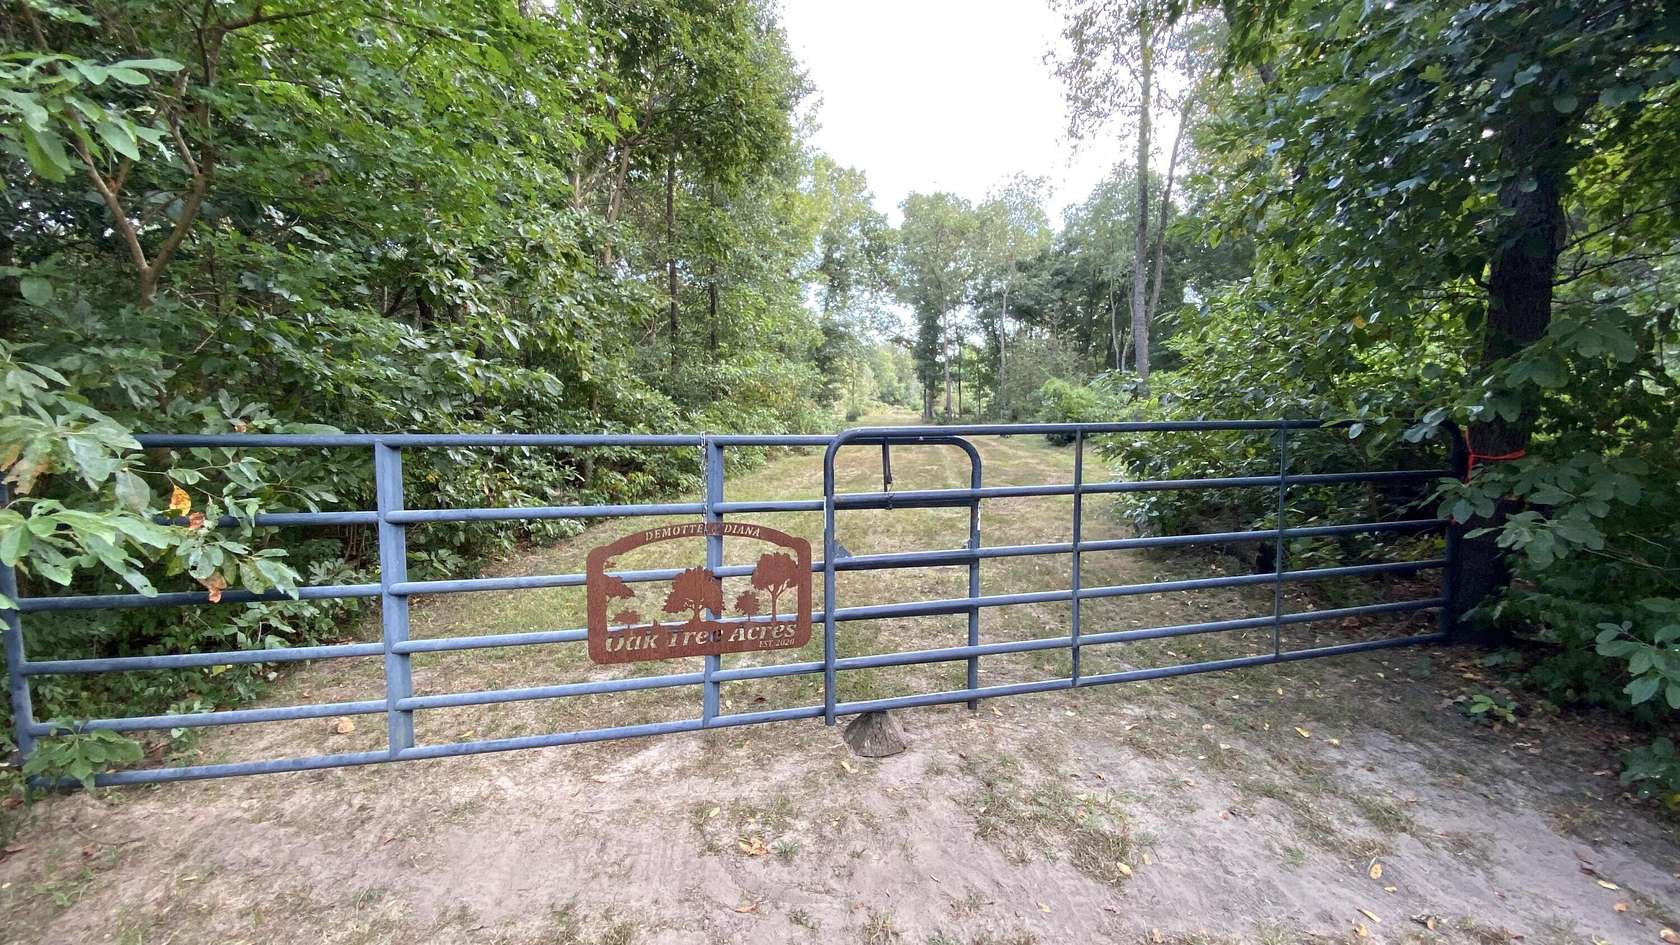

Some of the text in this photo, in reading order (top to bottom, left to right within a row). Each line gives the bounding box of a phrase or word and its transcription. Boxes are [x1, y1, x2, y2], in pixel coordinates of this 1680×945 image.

[709, 523, 760, 537] DIANA
[606, 623, 797, 652] Oak Tree Acres
[776, 638, 795, 647] 2020
